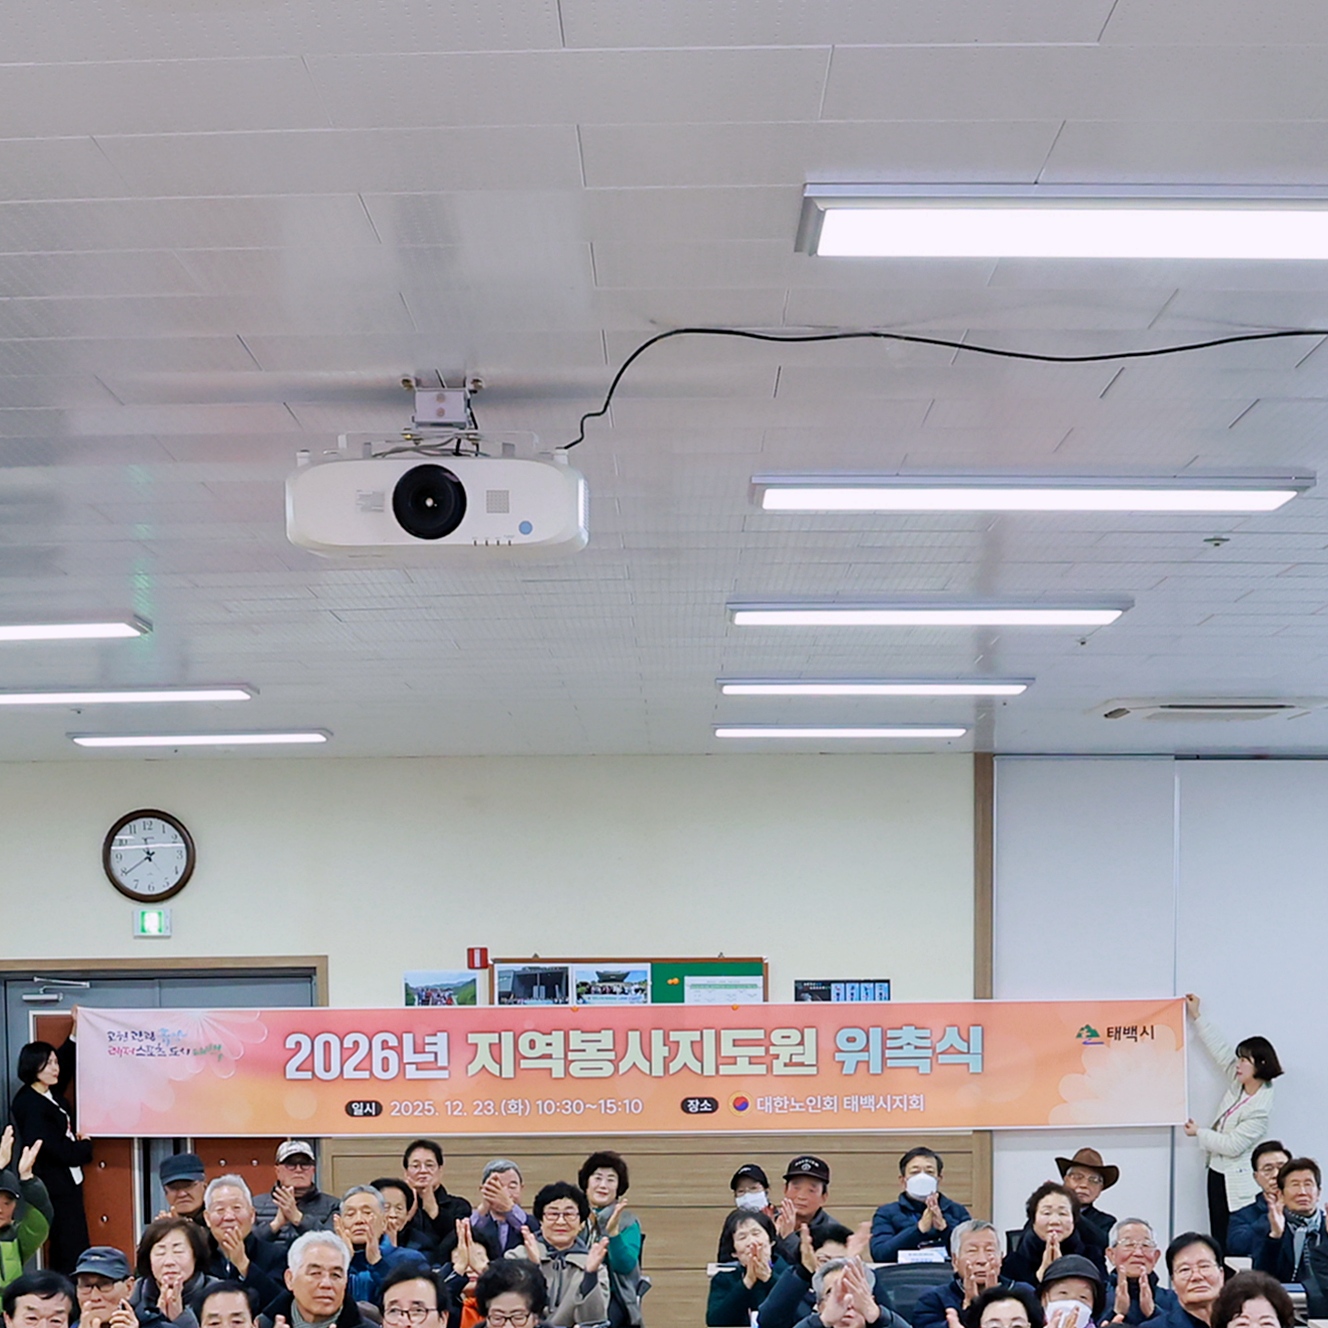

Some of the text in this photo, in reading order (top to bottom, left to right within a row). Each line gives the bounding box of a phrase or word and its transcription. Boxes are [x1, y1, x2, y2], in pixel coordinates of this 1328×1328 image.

[129, 824, 137, 834] 11
[142, 821, 153, 831] 12
[161, 824, 166, 834] 1
[115, 853, 123, 863] 9
[177, 850, 183, 859] 3
[133, 879, 139, 889] 7
[148, 882, 155, 892] 6
[1106, 1024, 1156, 1042] 태백시
[284, 1024, 984, 1081] 2026년 지역봉사지도원 위촉식
[351, 1102, 377, 1116] 일시
[390, 1101, 438, 1117] 2025.
[445, 1101, 467, 1116] 12.
[536, 1098, 643, 1115] 10:30~15:10
[686, 1093, 925, 1114] 장소 대한노인회 태백시지회
